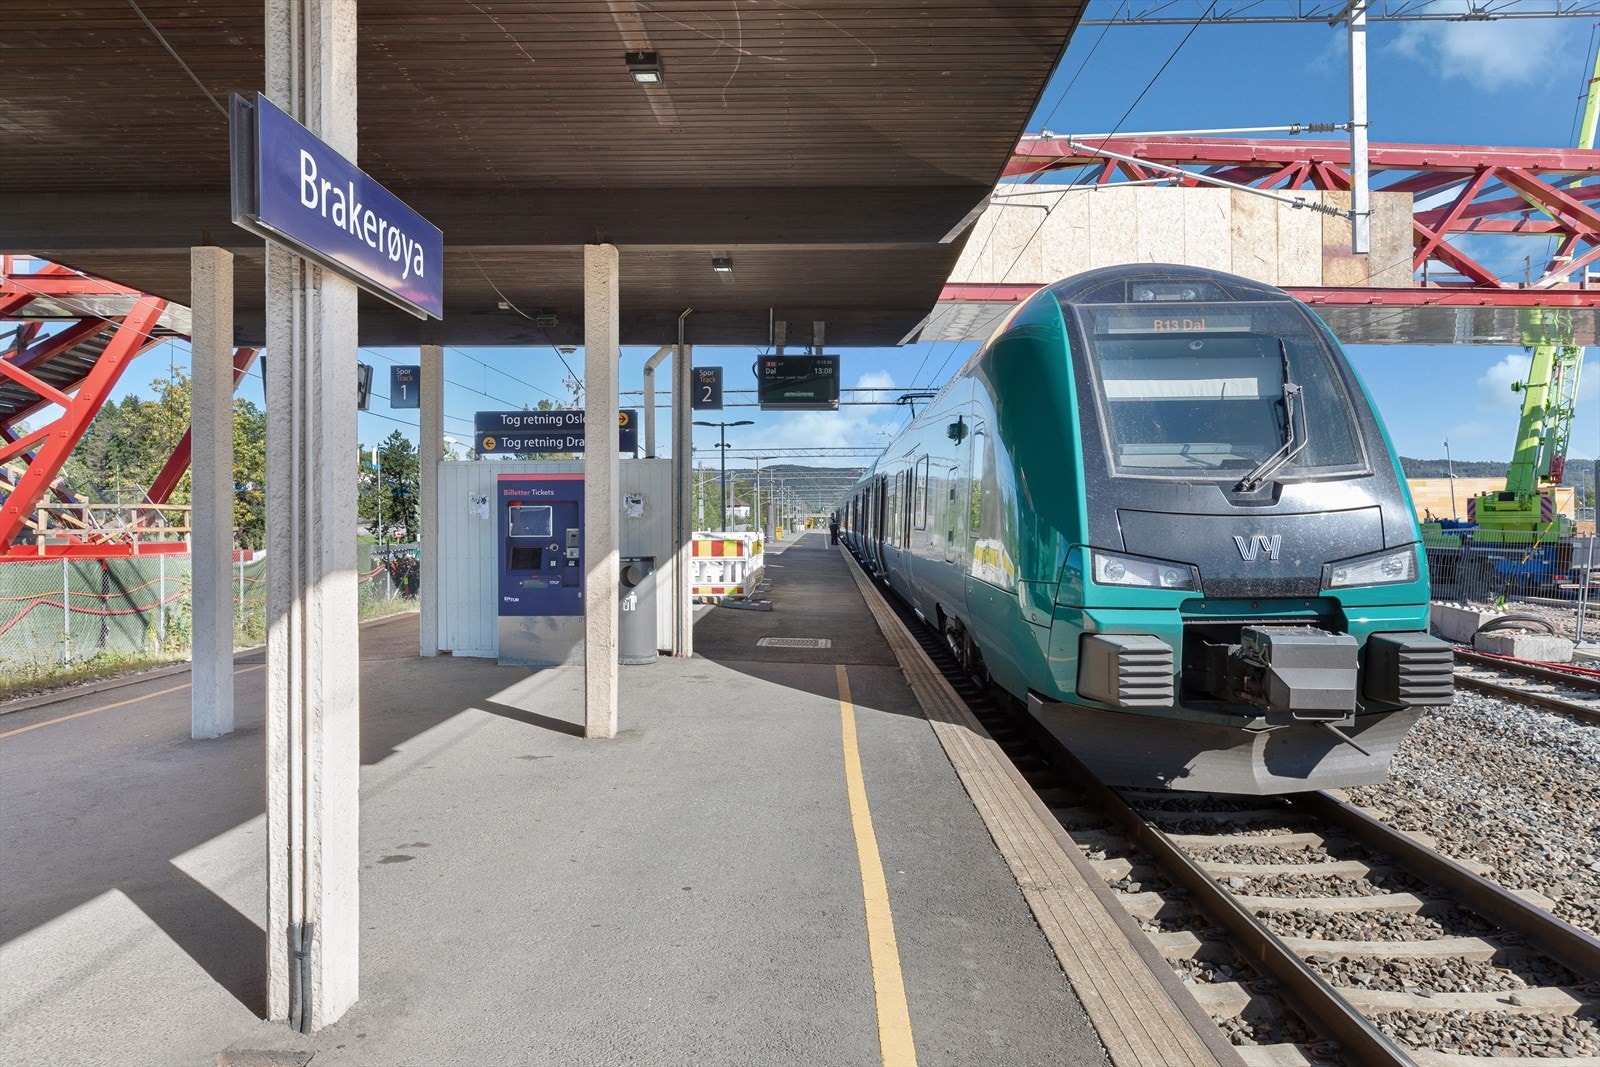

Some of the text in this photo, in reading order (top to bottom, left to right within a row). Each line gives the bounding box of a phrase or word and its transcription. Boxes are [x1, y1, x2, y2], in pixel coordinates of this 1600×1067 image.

[300, 148, 425, 280] Brakerøya
[1153, 319, 1206, 331] R13 Dal
[699, 369, 715, 377] Spor
[765, 367, 777, 375] Dal
[814, 367, 833, 375] 13:08
[400, 384, 406, 400] 1
[702, 385, 712, 402] 2
[501, 414, 521, 427] Tog
[523, 414, 563, 427] retning
[501, 437, 521, 449] Tog
[524, 437, 563, 449] retning
[1232, 534, 1282, 561] VY
